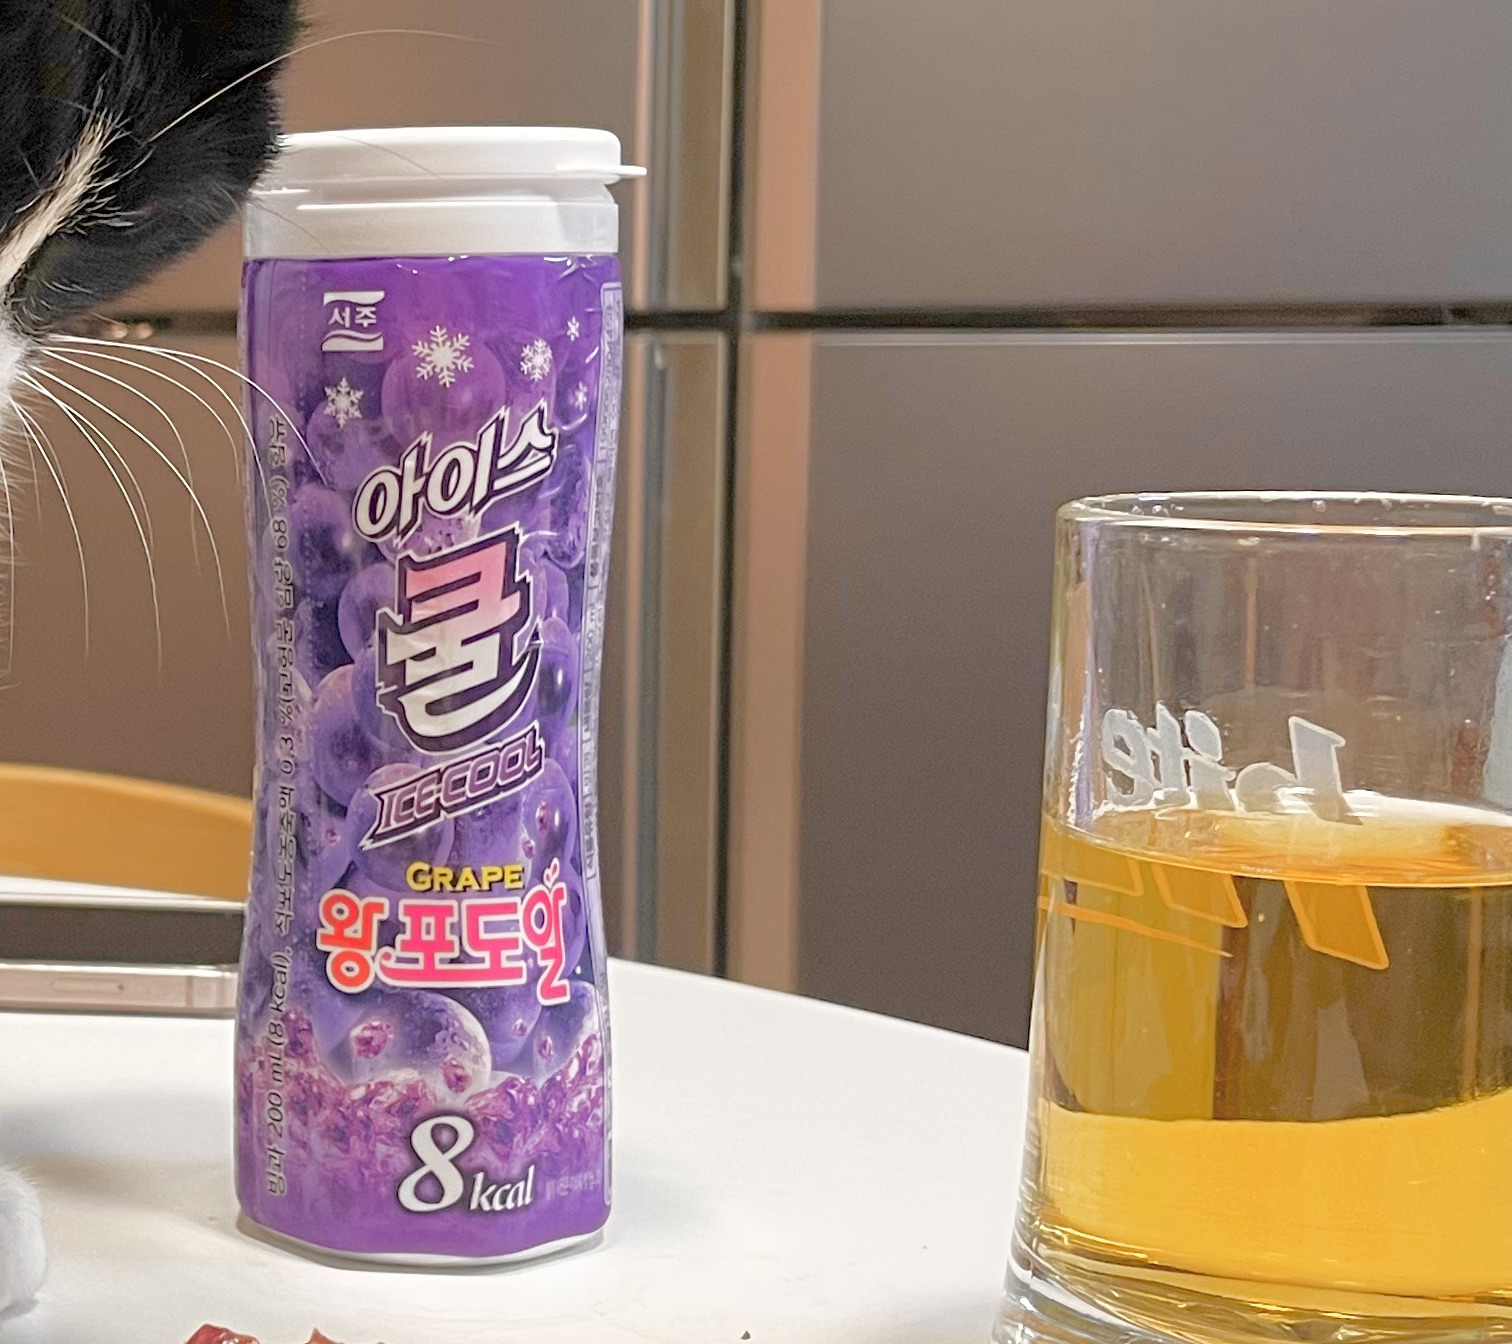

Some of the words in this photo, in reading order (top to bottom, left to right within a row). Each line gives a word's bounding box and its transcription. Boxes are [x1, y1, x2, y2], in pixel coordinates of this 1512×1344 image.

[328, 306, 378, 328] 서주
[269, 416, 287, 467] 함유
[351, 399, 559, 546] 아이스
[271, 519, 289, 550] 68
[273, 559, 293, 609] 함량
[375, 521, 544, 756] 쿨
[280, 735, 297, 776] 0.3
[266, 1092, 285, 1140] 200
[264, 1143, 285, 1197] 빙과
[397, 1115, 476, 1213] 8
[470, 1164, 535, 1211] kcal
